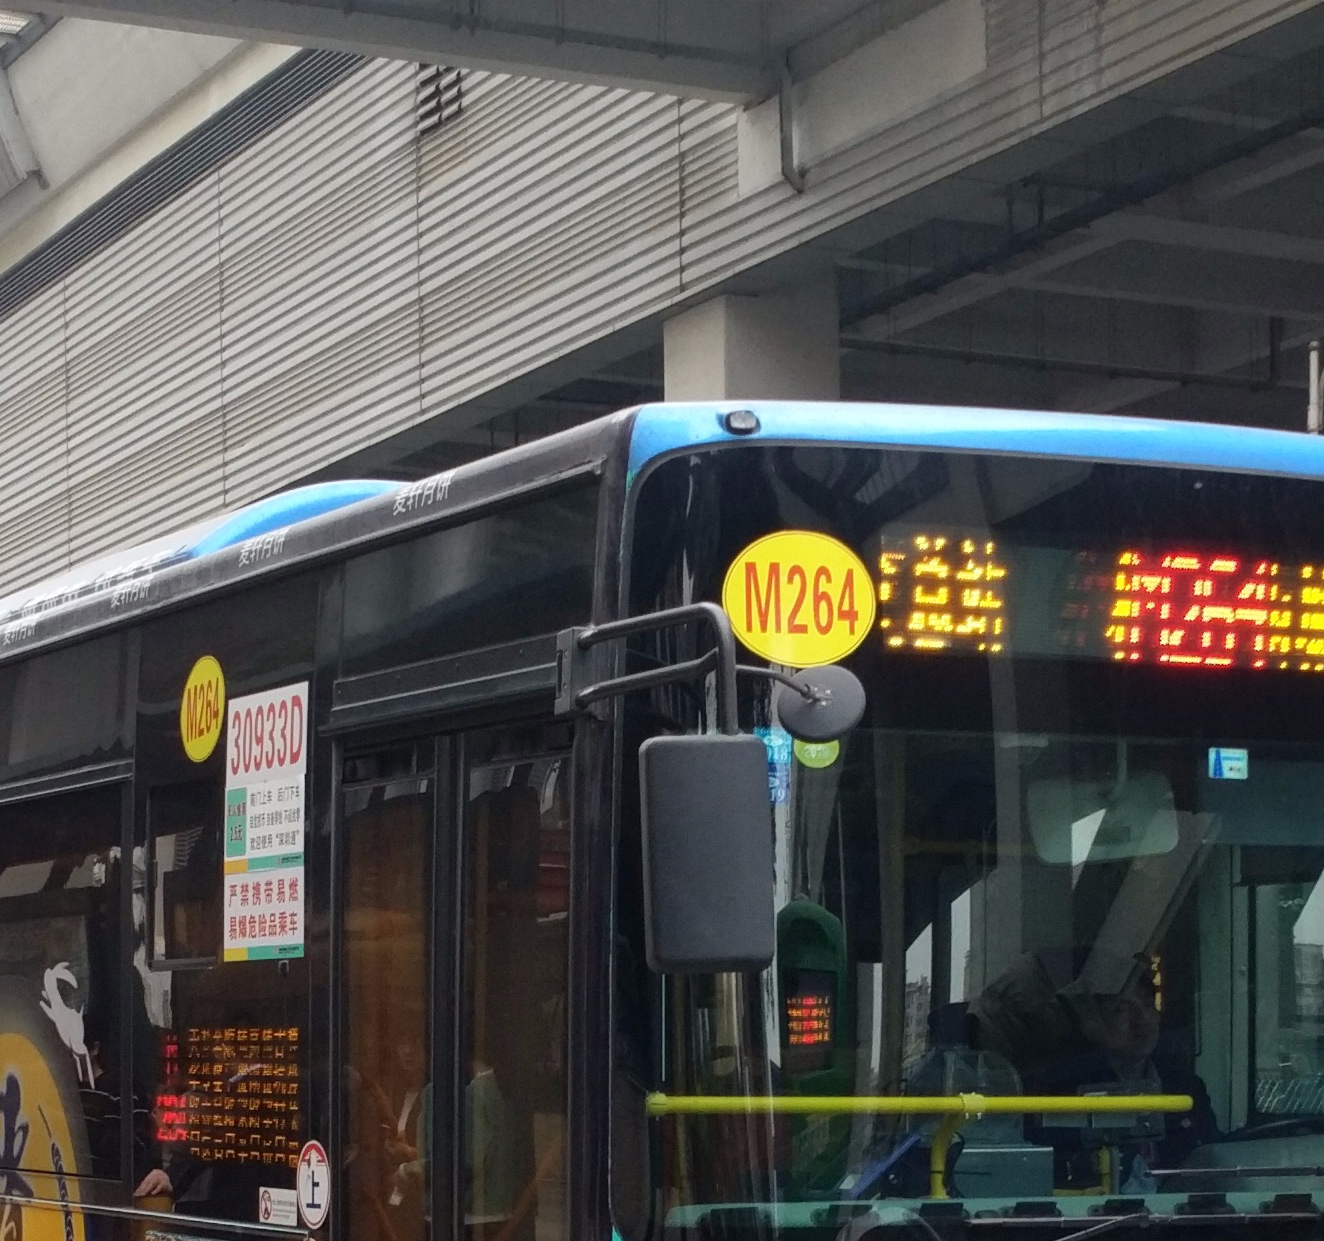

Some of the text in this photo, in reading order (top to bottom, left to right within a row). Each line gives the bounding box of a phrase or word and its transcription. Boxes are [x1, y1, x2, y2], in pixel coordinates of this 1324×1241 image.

[744, 560, 861, 636] M264
[185, 674, 221, 744] M264
[230, 694, 304, 777] 30933D
[228, 876, 300, 908] 严禁携带易燃
[228, 910, 299, 941] 易爆危险品乘车
[306, 1170, 322, 1209] 上
